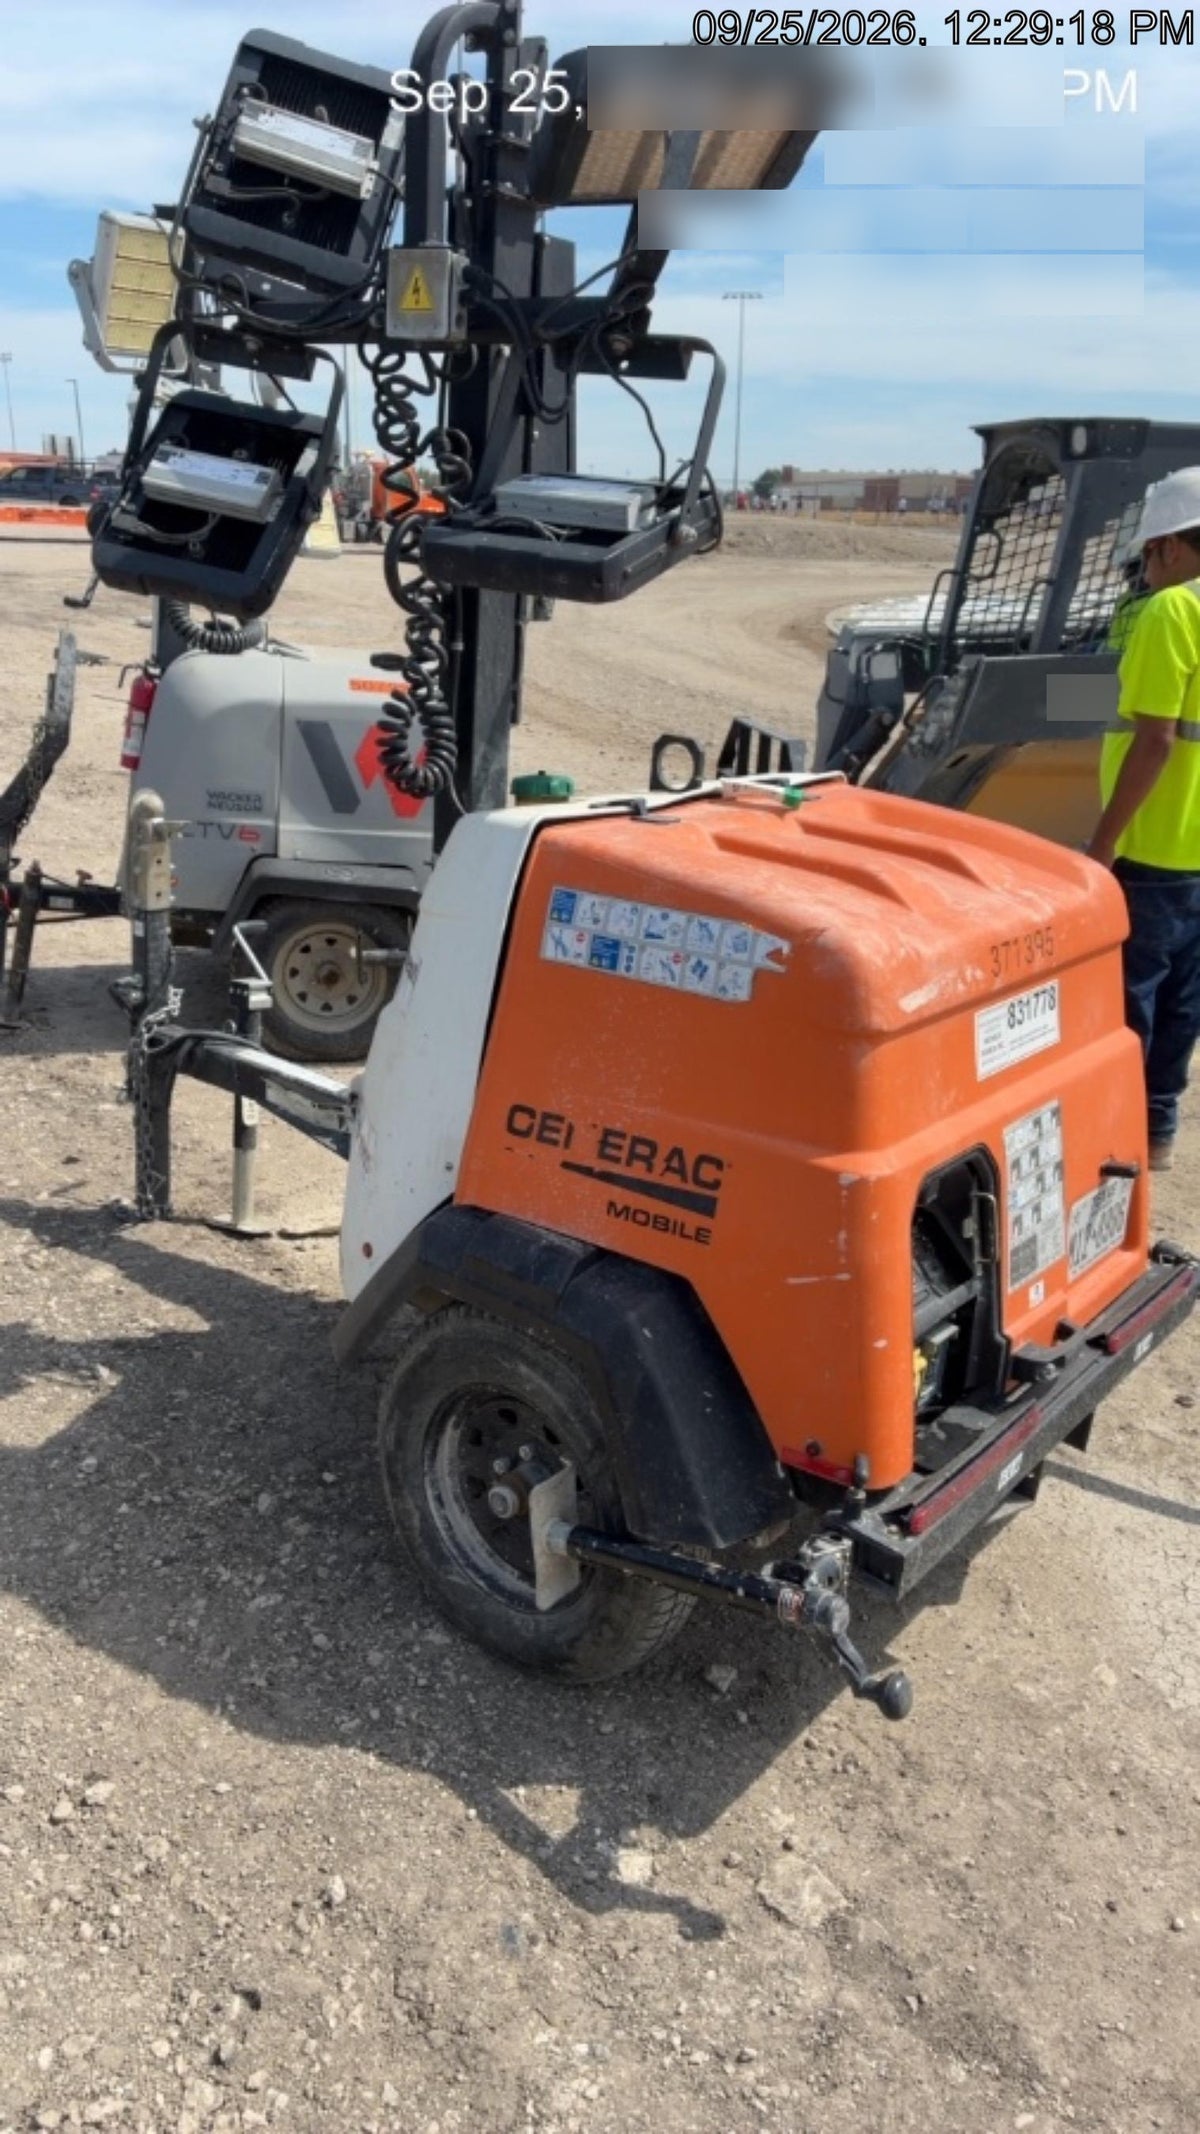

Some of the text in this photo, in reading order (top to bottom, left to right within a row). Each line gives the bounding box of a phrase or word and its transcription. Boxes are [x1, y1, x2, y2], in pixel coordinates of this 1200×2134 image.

[990, 925, 1054, 978] 371395
[1007, 985, 1057, 1029] 831778
[607, 1200, 713, 1245] MOBILE
